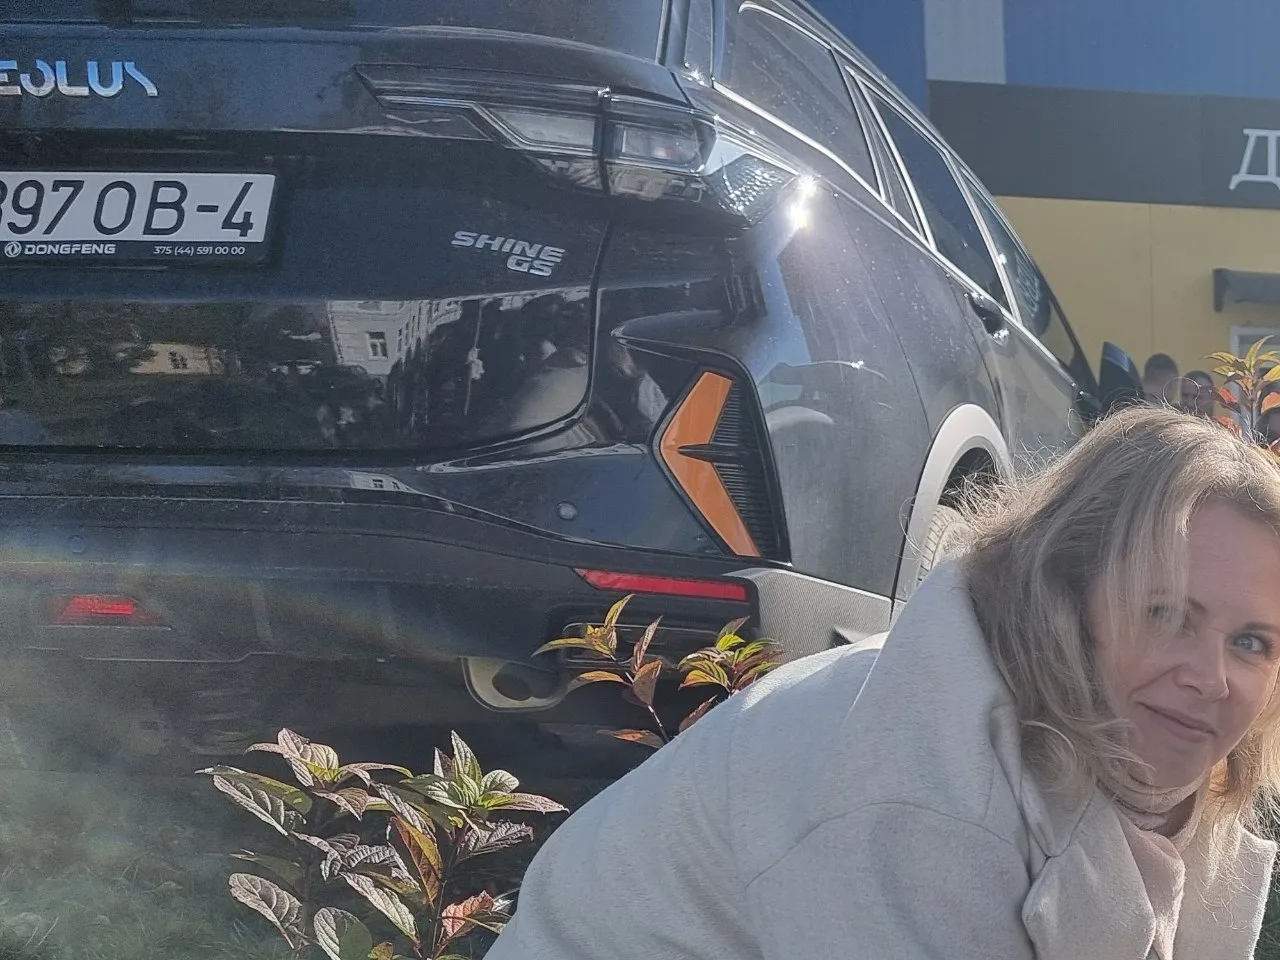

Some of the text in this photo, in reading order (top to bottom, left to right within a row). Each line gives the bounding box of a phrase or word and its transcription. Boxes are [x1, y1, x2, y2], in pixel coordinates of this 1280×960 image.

[0, 179, 85, 235] 97
[24, 243, 116, 255] DONGFENG
[153, 245, 245, 257] 375 (44) 591 00 00
[451, 230, 566, 263] SHINE
[506, 254, 555, 277] GS
